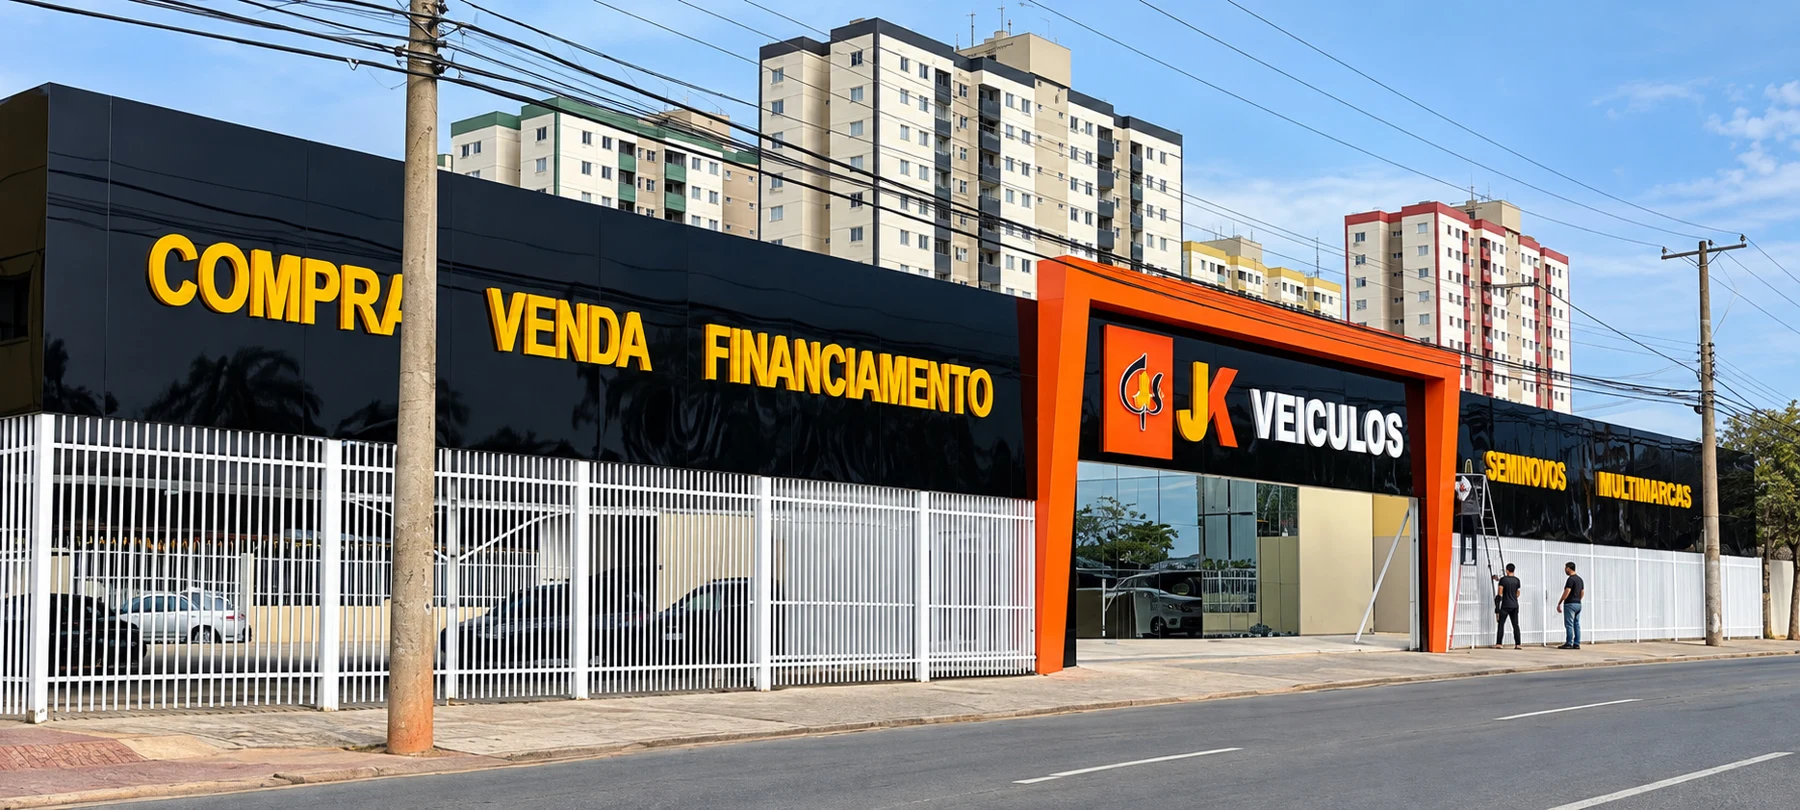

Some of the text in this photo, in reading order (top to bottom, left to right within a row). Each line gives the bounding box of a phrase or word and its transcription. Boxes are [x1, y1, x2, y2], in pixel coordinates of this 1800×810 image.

[486, 287, 653, 372] VENDA
[704, 323, 994, 418] FINANCIAMENTO
[1175, 361, 1404, 459] JK VEICULOS
[1484, 450, 1692, 509] SEMINOVOS MULTIMARCAS
